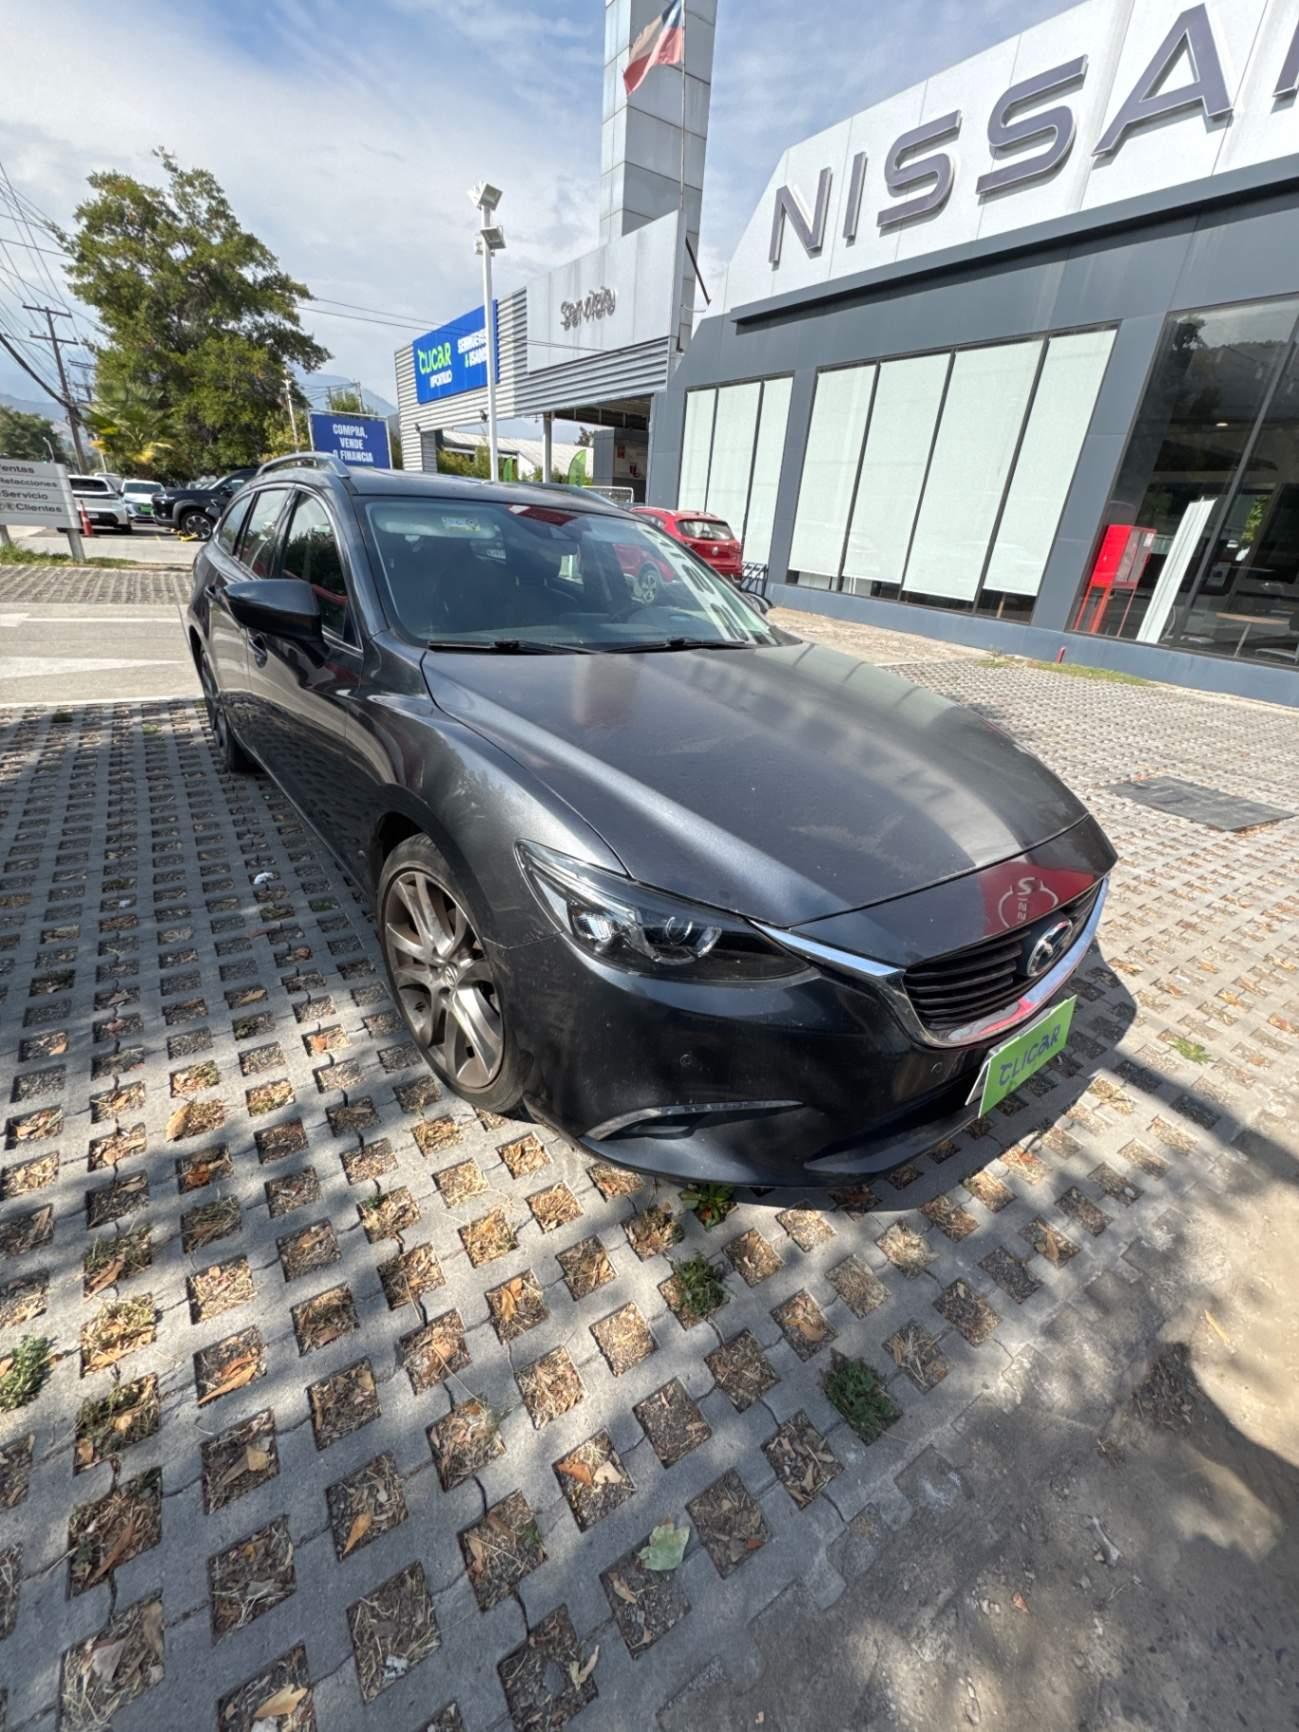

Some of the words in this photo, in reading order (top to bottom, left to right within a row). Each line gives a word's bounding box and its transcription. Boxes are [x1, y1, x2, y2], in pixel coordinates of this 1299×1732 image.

[769, 2, 1299, 266] NISSA
[339, 436, 364, 450] VENDE
[340, 449, 374, 463] FINANCIA
[0, 464, 35, 474] entas
[1, 489, 49, 500] Servicio
[15, 502, 63, 513] Clientes
